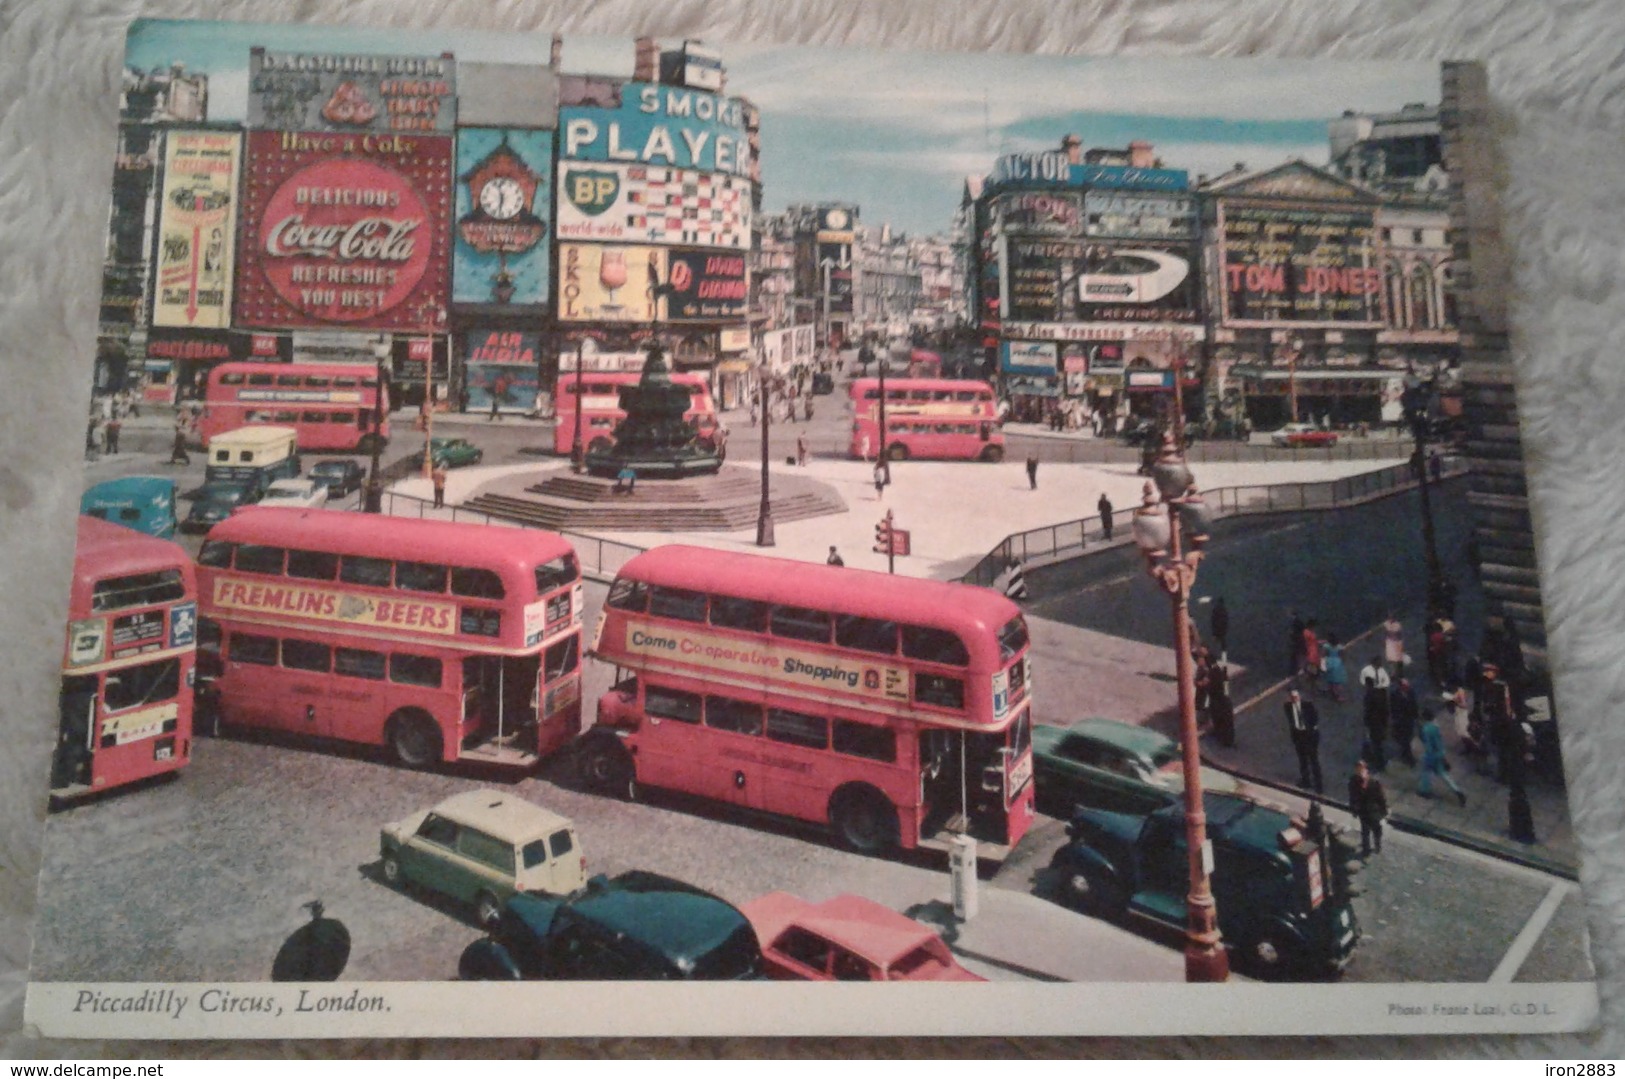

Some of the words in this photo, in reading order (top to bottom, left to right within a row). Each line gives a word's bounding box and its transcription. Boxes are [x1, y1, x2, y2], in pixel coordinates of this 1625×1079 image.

[282, 132, 334, 151] Have
[362, 135, 416, 154] Coke
[296, 187, 400, 206] DELICIOUS
[574, 177, 616, 205] BP
[291, 265, 398, 284] REFRESHES
[564, 249, 580, 317] SKOL
[1226, 262, 1285, 294] TOM
[1298, 266, 1380, 295] JONES
[300, 288, 335, 306] YOU
[485, 332, 522, 346] AIR
[472, 347, 534, 362] INDIA
[218, 581, 337, 614] FREMLINS
[375, 601, 450, 629] BEERS
[632, 630, 676, 650] Come
[783, 657, 859, 687] Shopping
[72, 989, 188, 1019] Piccadilly
[199, 989, 284, 1017] Circus,
[295, 989, 392, 1013] London.
